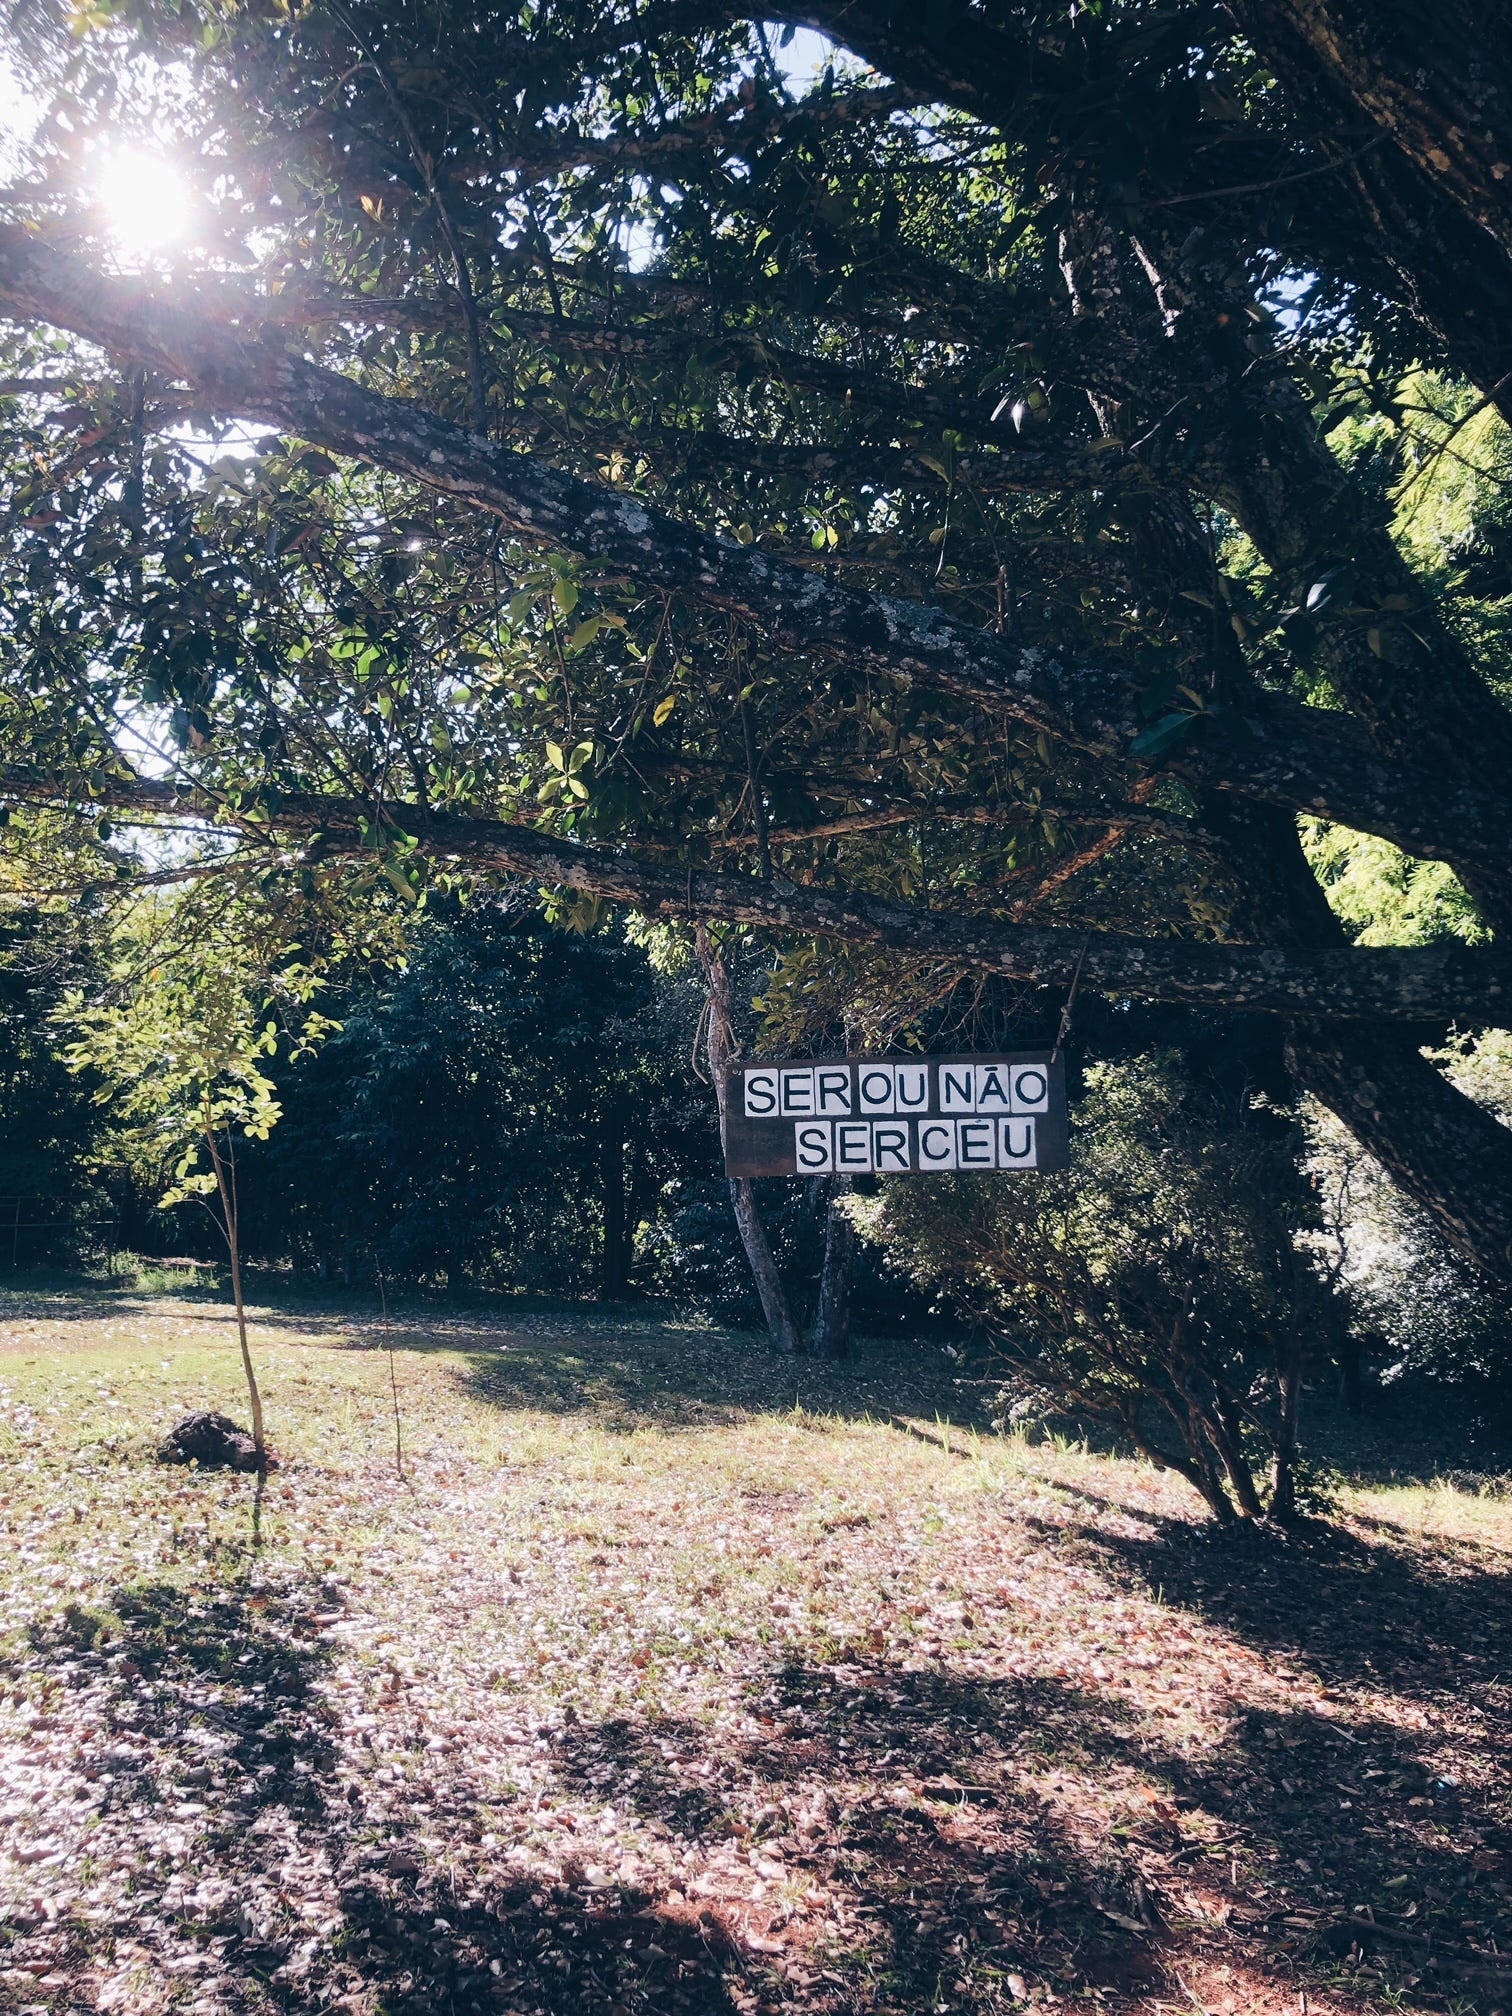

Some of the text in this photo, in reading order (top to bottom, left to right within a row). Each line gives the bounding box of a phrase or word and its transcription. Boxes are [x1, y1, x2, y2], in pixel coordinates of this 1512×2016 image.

[747, 1066, 1047, 1113] SER OU NÃO
[798, 1119, 1031, 1167] SER CÉU
